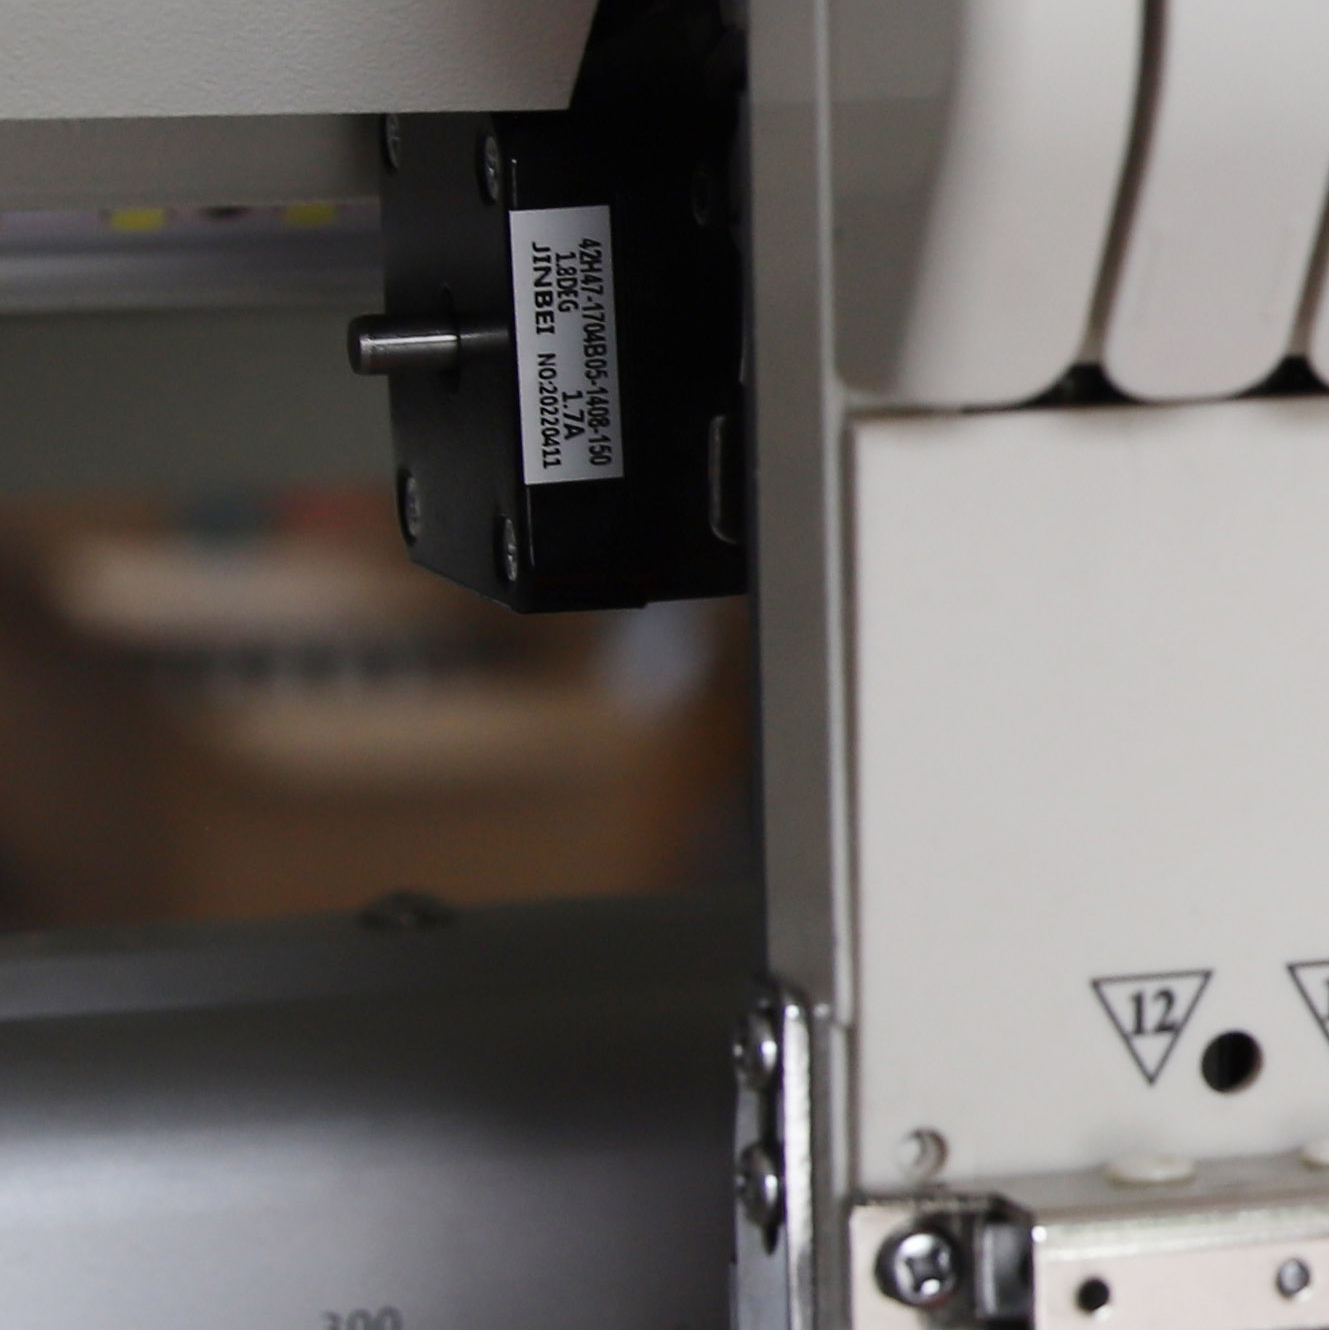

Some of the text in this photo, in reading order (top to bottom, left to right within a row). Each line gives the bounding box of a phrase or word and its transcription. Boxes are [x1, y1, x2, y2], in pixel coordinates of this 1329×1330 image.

[531, 241, 562, 470] JINBEI NO:20220411
[556, 251, 586, 440] 1.8DEG 1.7A
[1129, 988, 1182, 1038] 12
